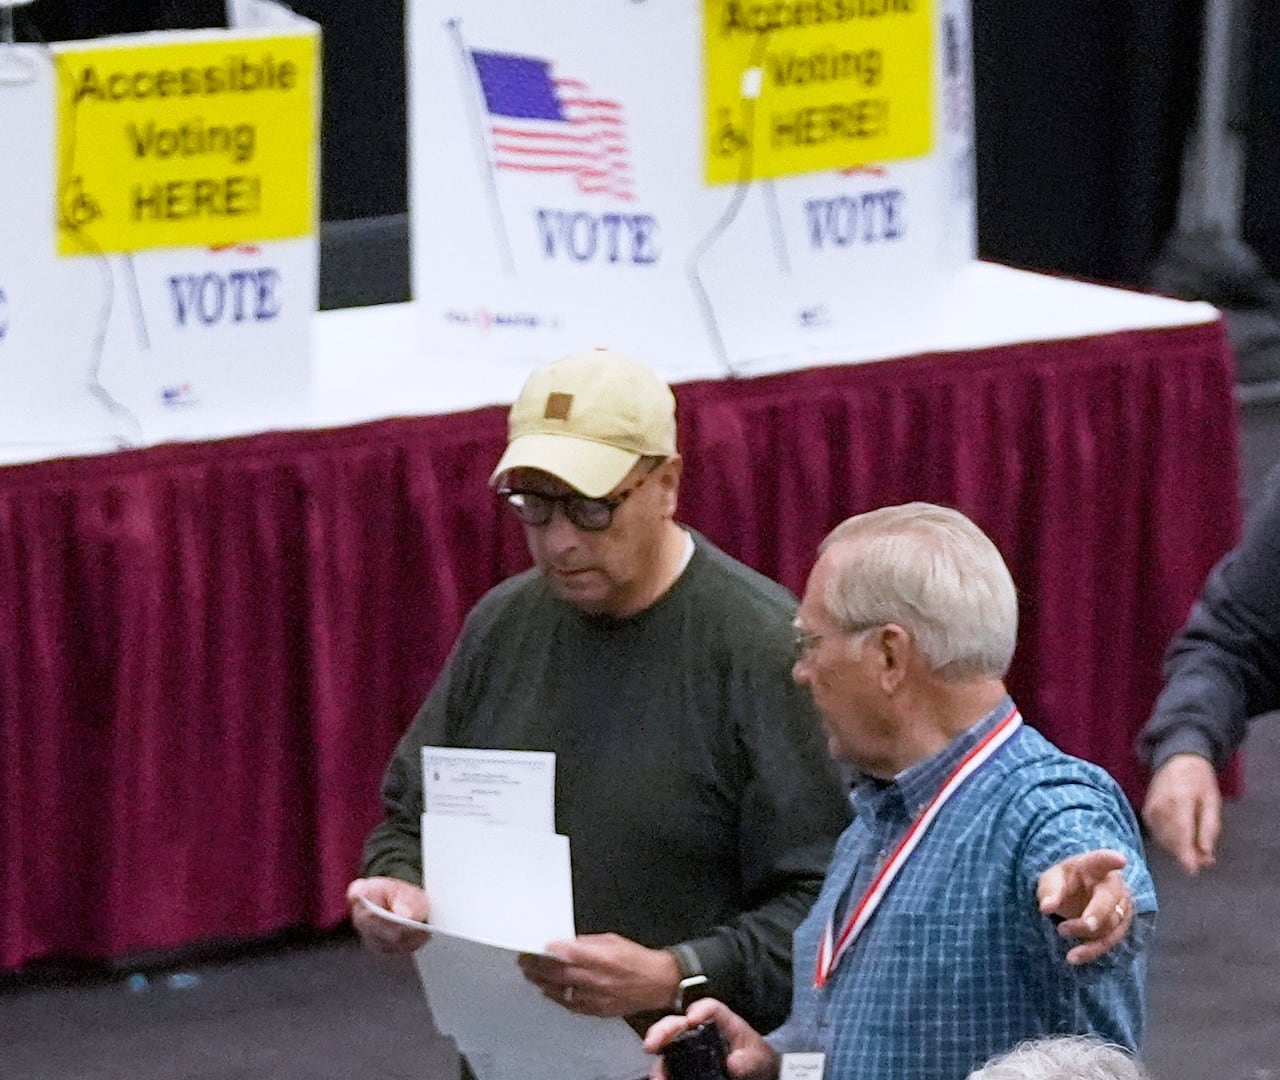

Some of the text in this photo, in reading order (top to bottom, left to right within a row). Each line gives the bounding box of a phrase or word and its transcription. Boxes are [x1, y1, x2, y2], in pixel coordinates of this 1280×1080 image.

[72, 52, 296, 106] Accessible
[770, 46, 882, 87] Voting
[125, 118, 256, 163] Voting
[771, 99, 888, 148] HERE!
[131, 174, 261, 221] HERE!
[805, 188, 904, 248] VOTE
[534, 207, 659, 265] VOTE
[168, 267, 280, 325] VOTE
